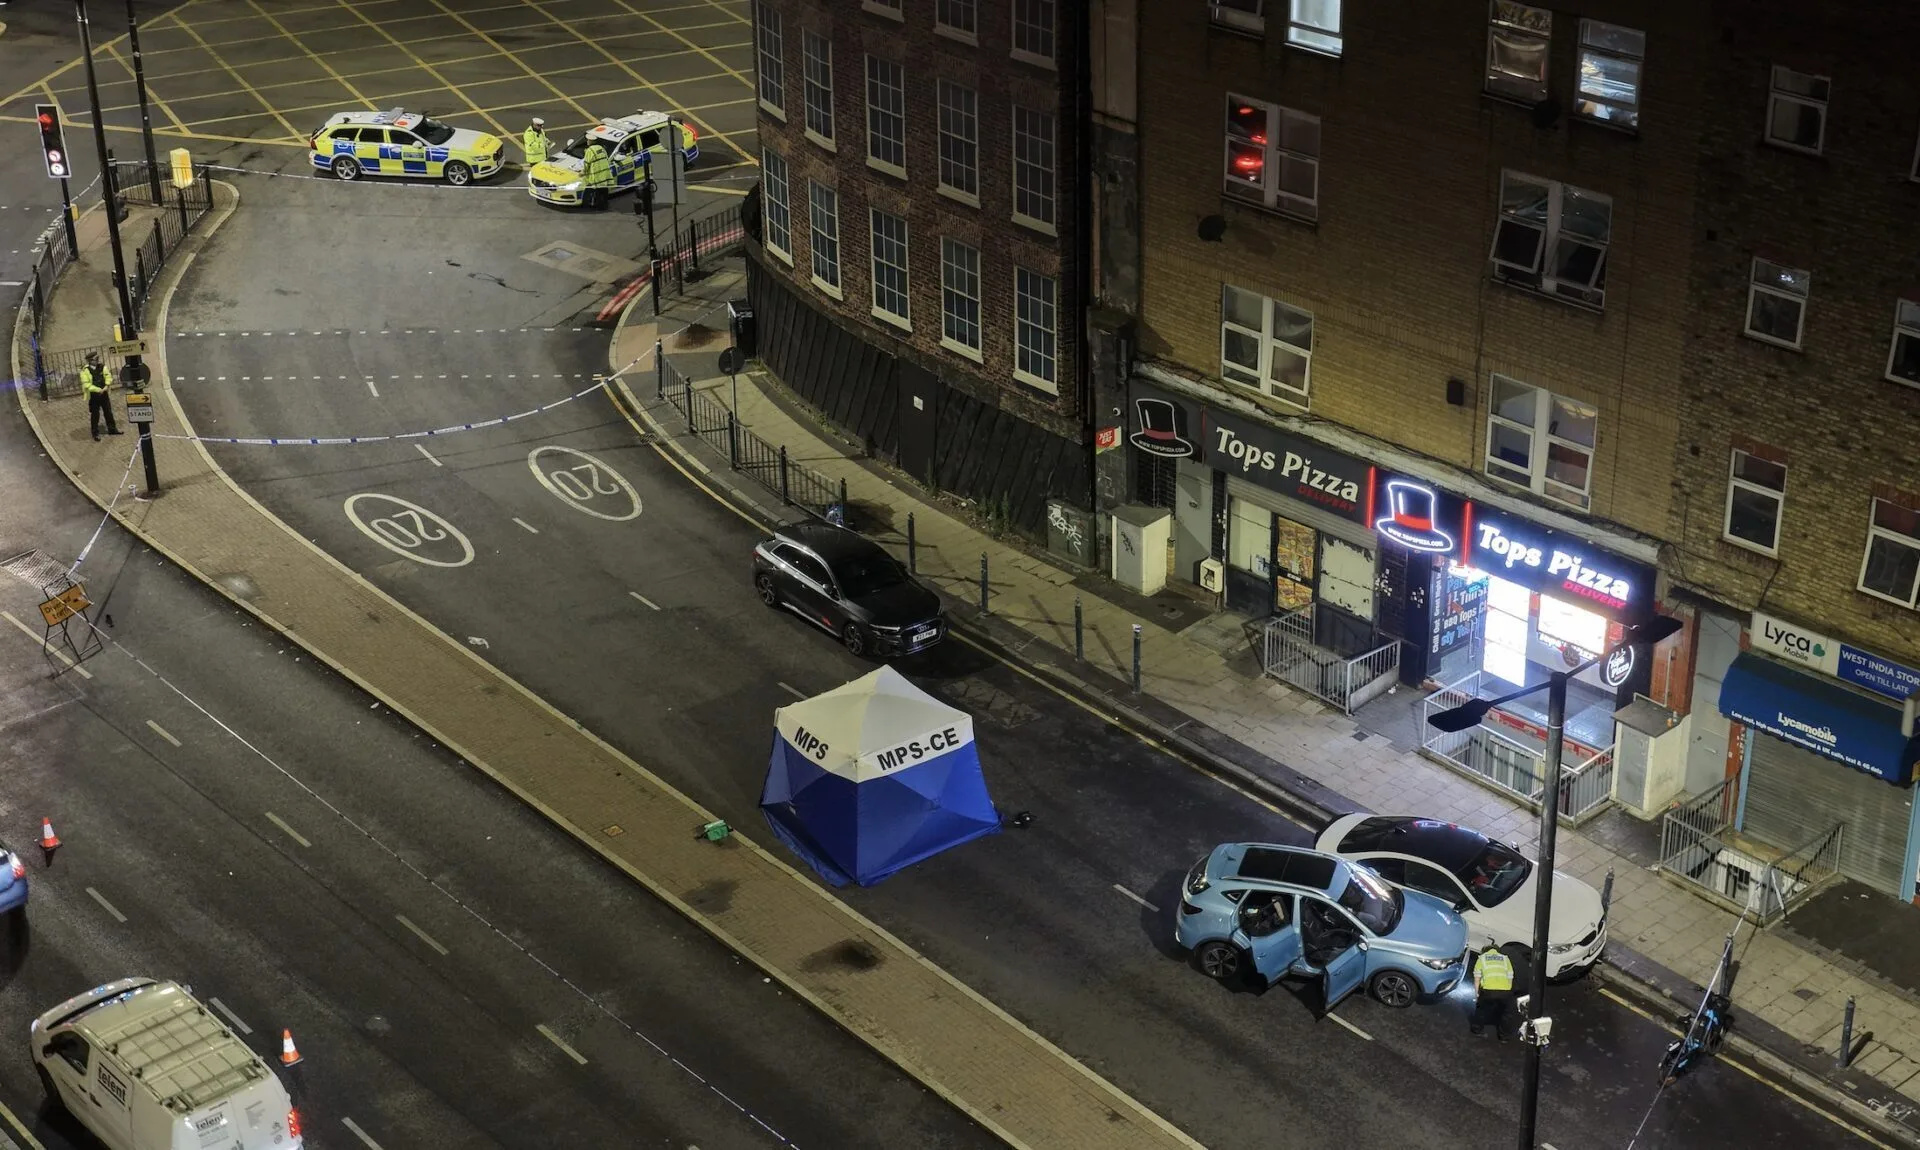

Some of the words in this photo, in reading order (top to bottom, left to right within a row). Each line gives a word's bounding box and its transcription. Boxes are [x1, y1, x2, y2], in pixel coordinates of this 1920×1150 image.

[1216, 426, 1276, 472] Tops
[1281, 451, 1359, 503] Pizza
[551, 462, 620, 501] 20
[1297, 483, 1356, 513] DELIVERY
[370, 510, 447, 548] 20
[1478, 522, 1542, 569] Tops
[1547, 550, 1630, 601] Pizza
[1562, 580, 1627, 609] DELIVERY
[1764, 620, 1811, 653] Lyca
[1610, 654, 1625, 670] Tops
[1610, 662, 1630, 679] Pizza
[1783, 646, 1809, 662] Mobile
[1841, 650, 1867, 666] WEST
[1868, 659, 1895, 680] INDIA
[1855, 668, 1876, 683] OPEN
[1876, 675, 1891, 688] TILL
[1891, 681, 1910, 695] LATE
[794, 726, 829, 760] MPS
[1731, 710, 1743, 719] Low
[1755, 720, 1767, 729] high
[1767, 726, 1784, 737] quality
[1822, 746, 1831, 755] UK
[1845, 755, 1857, 765] text
[1870, 766, 1883, 775] data
[1777, 711, 1837, 744] Lycamobile
[876, 727, 960, 771] MPS-CE
[98, 1066, 127, 1102] telent
[196, 1111, 224, 1132] telent
